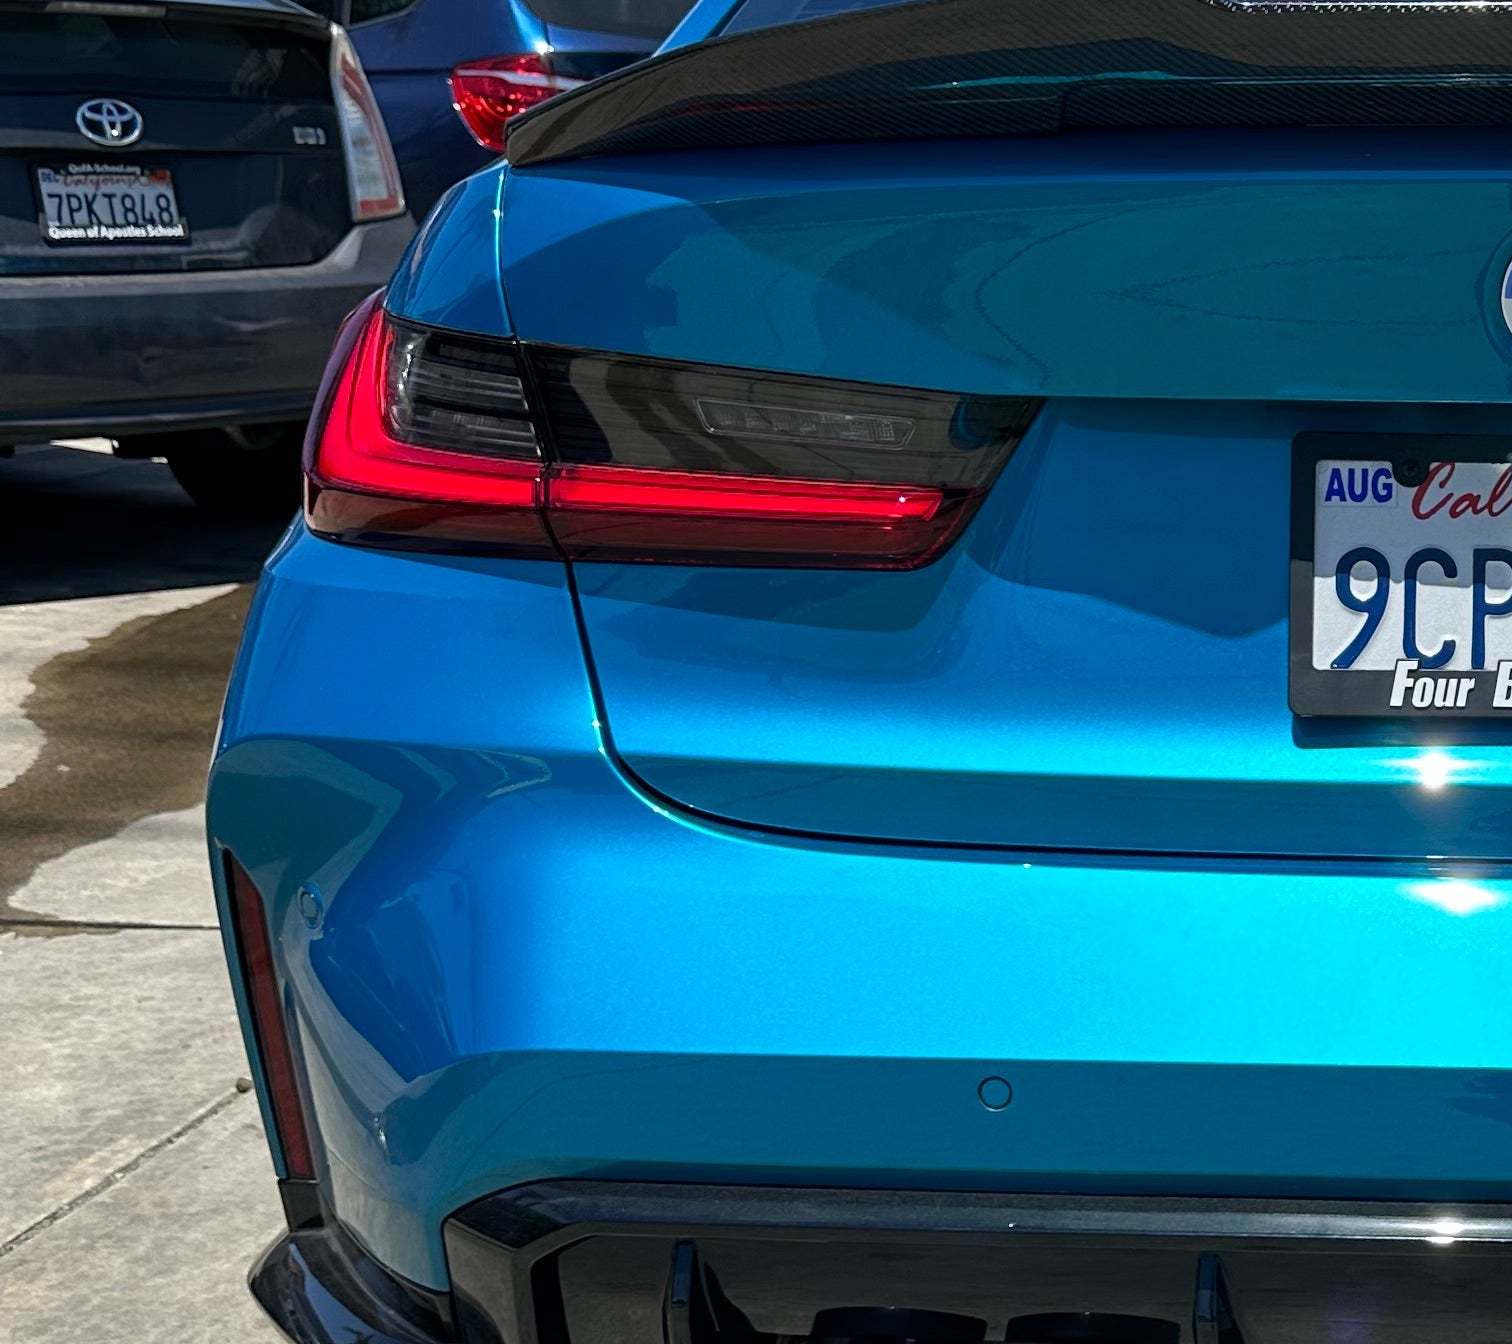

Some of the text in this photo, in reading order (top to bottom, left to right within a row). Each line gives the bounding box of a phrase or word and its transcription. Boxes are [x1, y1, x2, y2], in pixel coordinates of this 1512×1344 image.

[47, 193, 174, 226] 7PKT848
[49, 223, 184, 240] Queen of Apostles School
[1324, 467, 1394, 503] AUG
[1389, 659, 1475, 710] Four
